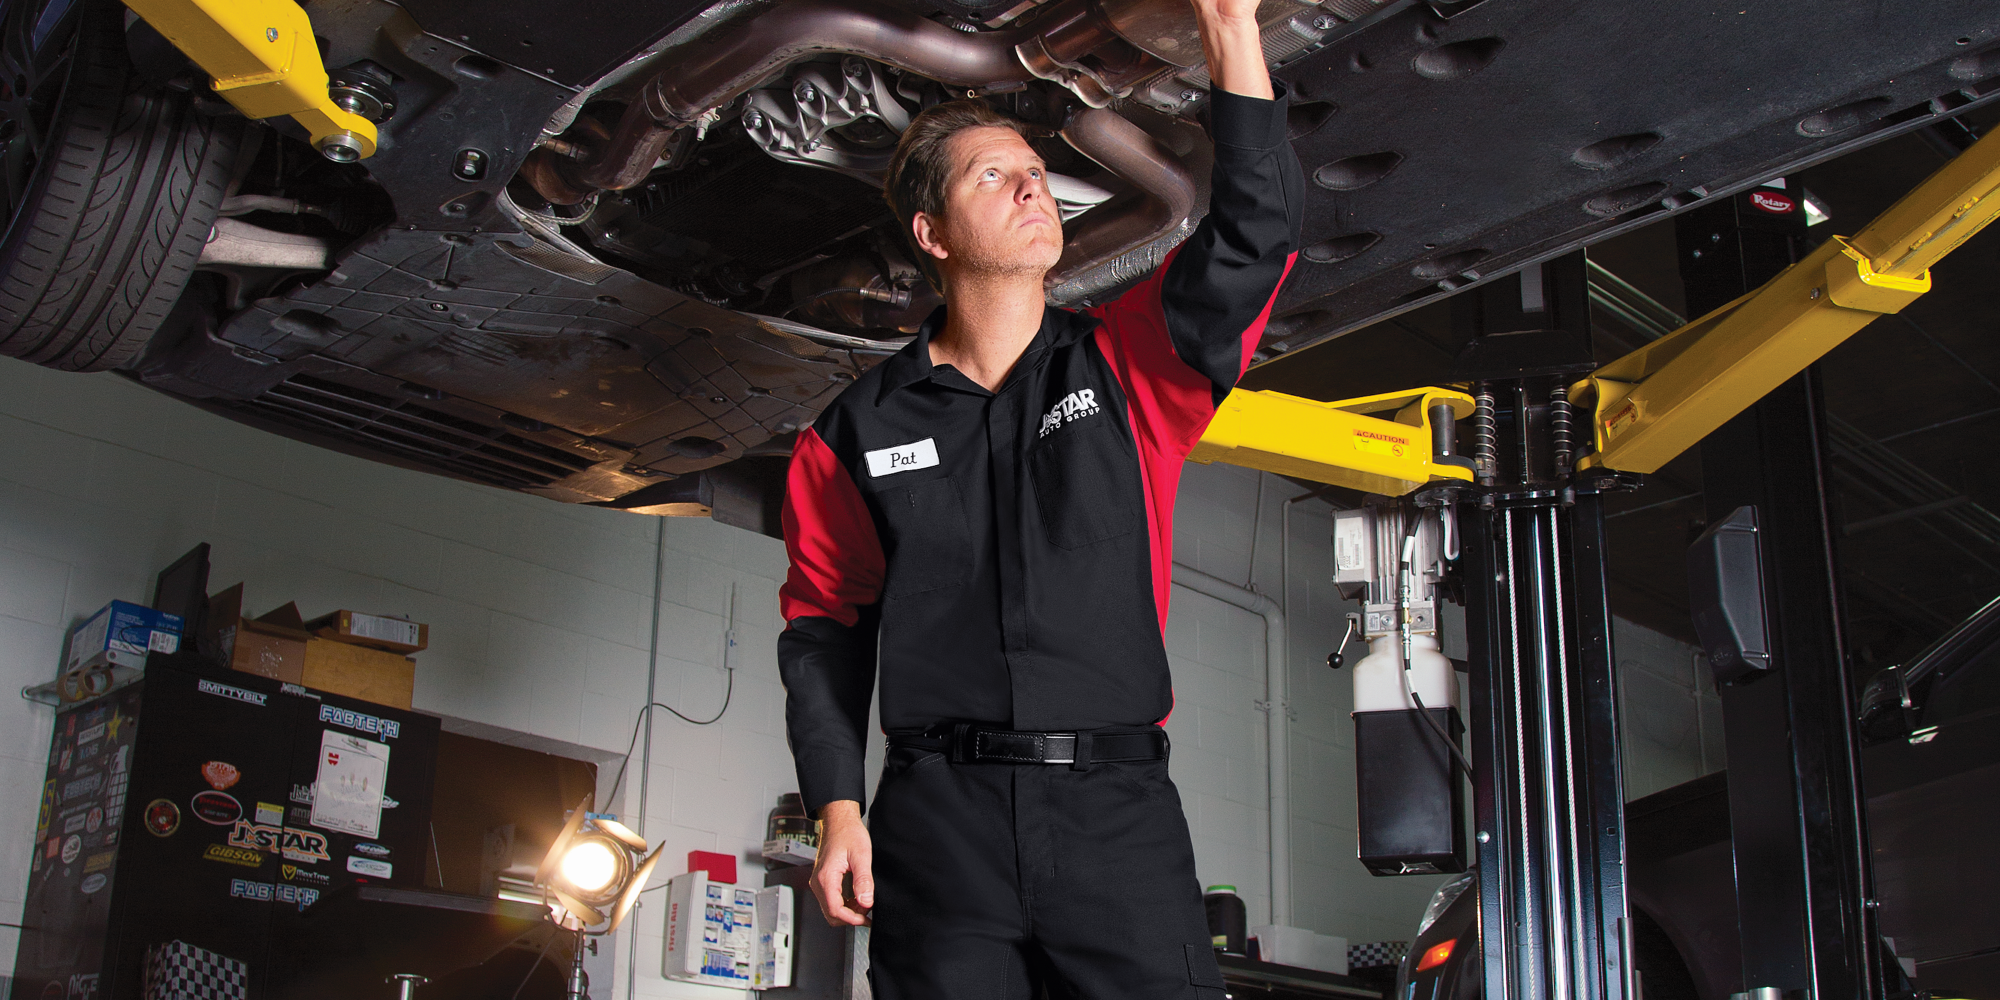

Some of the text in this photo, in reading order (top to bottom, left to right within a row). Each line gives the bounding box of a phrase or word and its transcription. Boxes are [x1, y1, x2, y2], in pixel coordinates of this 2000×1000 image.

[1752, 193, 1790, 211] Rotary
[1040, 406, 1100, 439] AUTO GROUP
[1362, 431, 1405, 444] CAUTION
[890, 452, 917, 469] Pat
[198, 679, 267, 705] SMITTYBILT
[319, 704, 400, 741] FABTECH
[209, 846, 263, 863] GIBSON
[231, 878, 319, 911] FABTECH
[670, 903, 678, 922] Aid
